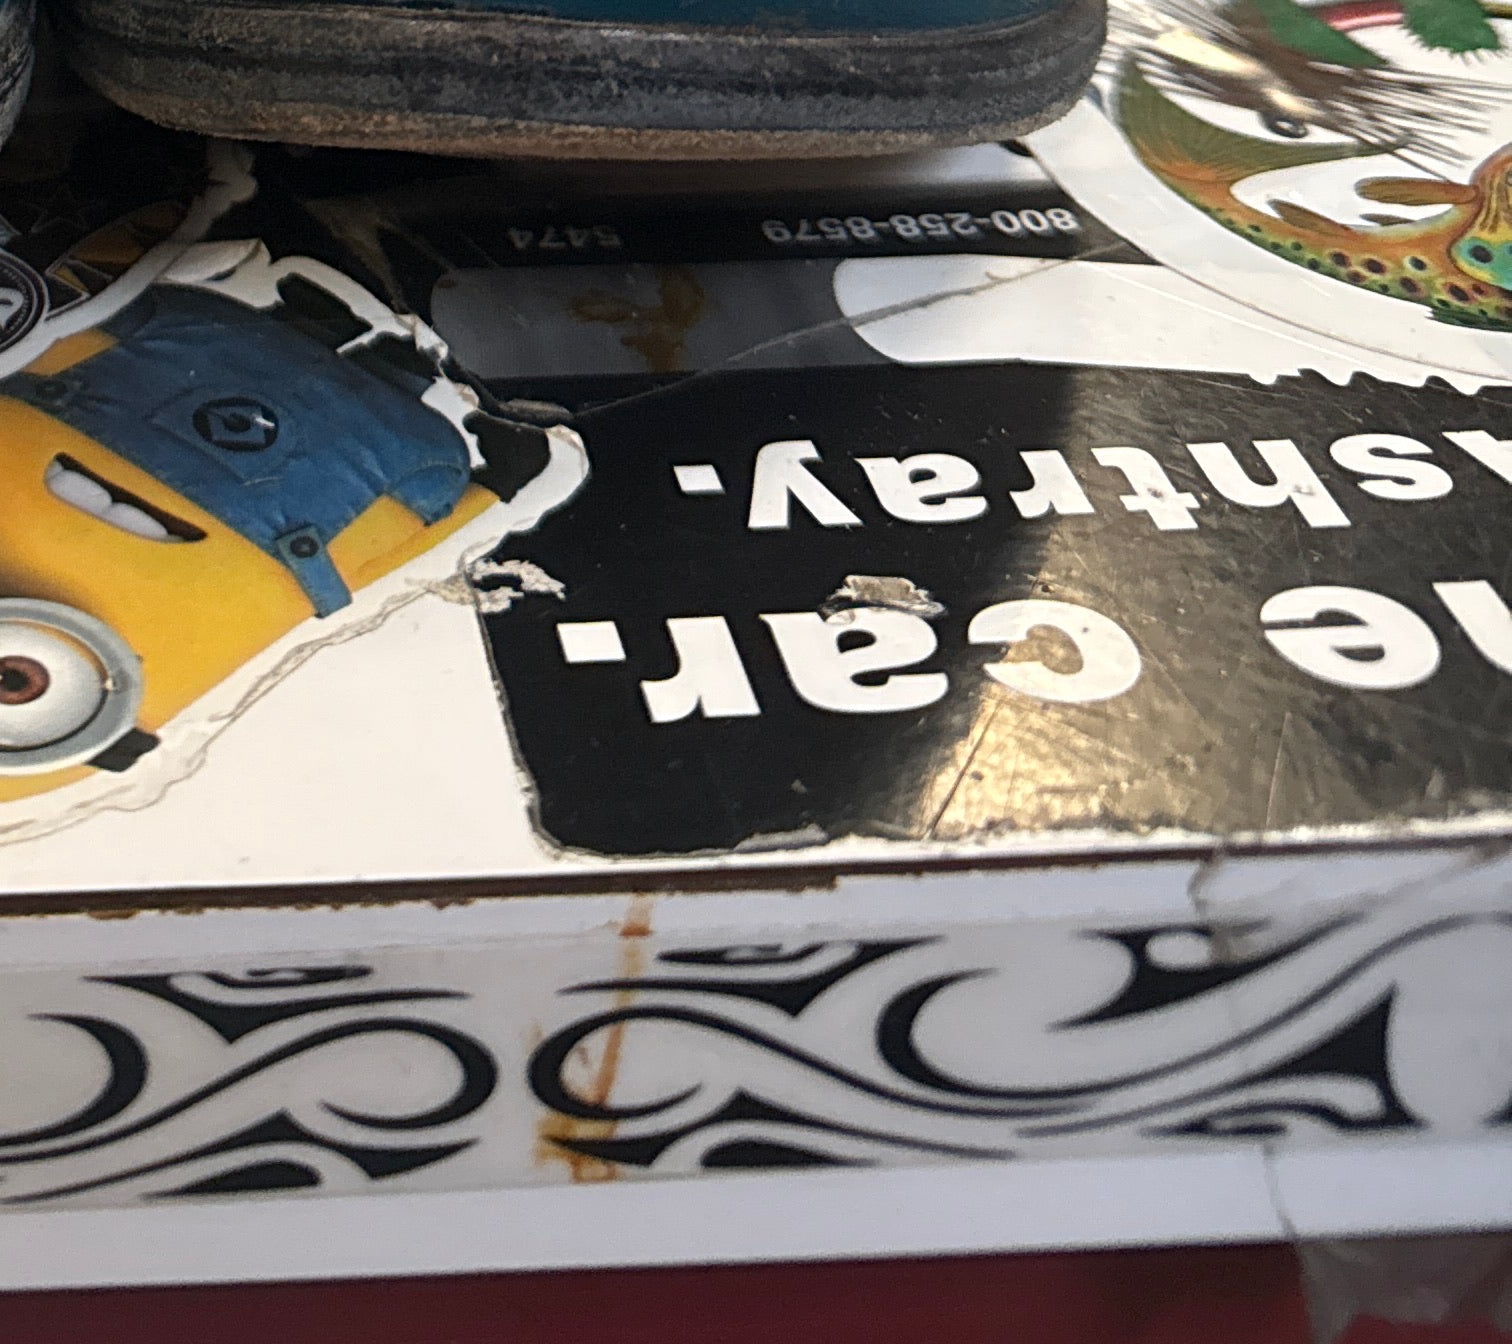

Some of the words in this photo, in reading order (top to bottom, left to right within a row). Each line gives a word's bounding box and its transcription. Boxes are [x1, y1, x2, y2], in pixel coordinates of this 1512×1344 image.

[506, 222, 625, 251] 5474
[760, 206, 1080, 245] 800-258-8579
[555, 598, 1143, 723] car.
